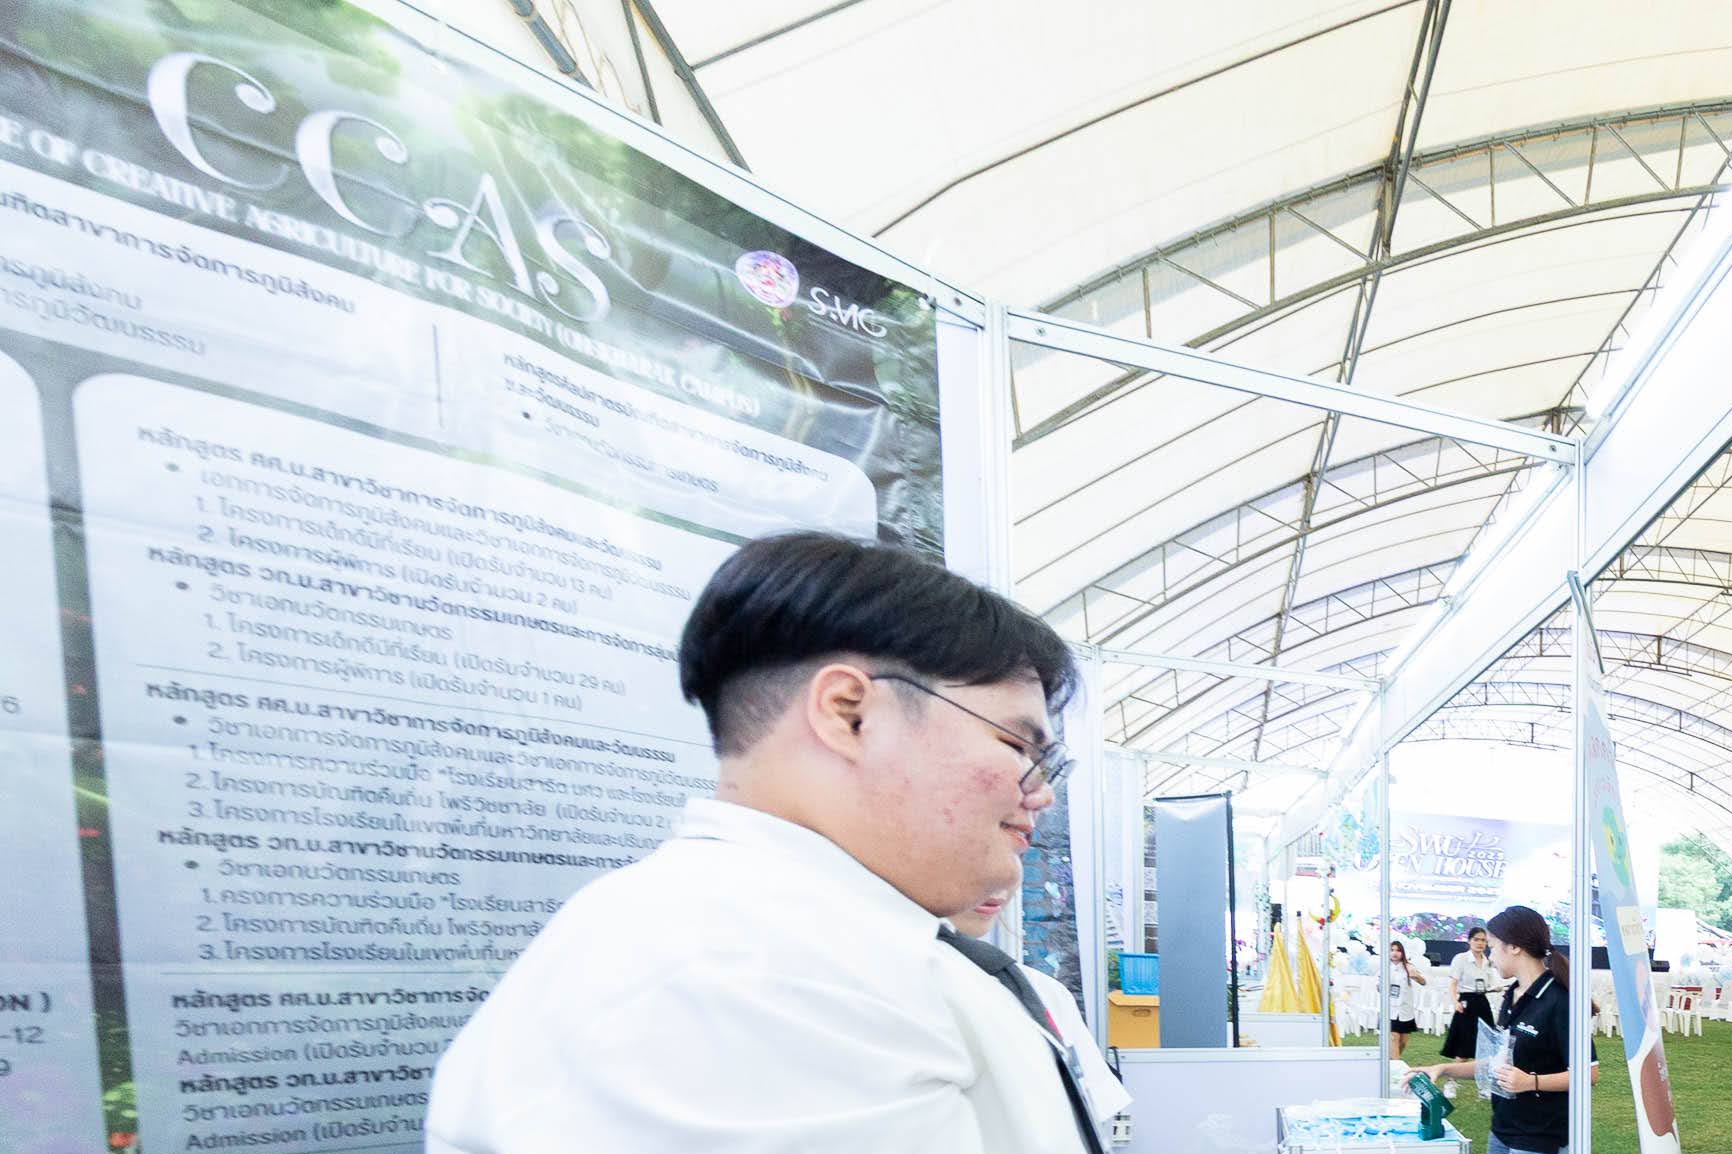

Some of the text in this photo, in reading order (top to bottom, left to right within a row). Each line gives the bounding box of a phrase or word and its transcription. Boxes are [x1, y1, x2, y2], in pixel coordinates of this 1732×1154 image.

[81, 148, 240, 226] CREATIVE
[136, 424, 244, 462] หลักสูตร
[145, 545, 252, 578] หลักสูตร
[209, 582, 454, 641] วิชาเอกนวัตกรรมเกษตร
[144, 680, 250, 711] หลักสูตร
[156, 824, 261, 853] หลักสูตร
[217, 858, 462, 887] วิชาเอกนวัตกรรมเกษตร
[171, 989, 272, 1013] หลักสูตร
[176, 1046, 299, 1067] Admission
[177, 1072, 280, 1096] หลักสูตร
[182, 1090, 428, 1123] วิชาเอกนวัตกรรมเกษตร
[185, 1126, 308, 1152] Admission
